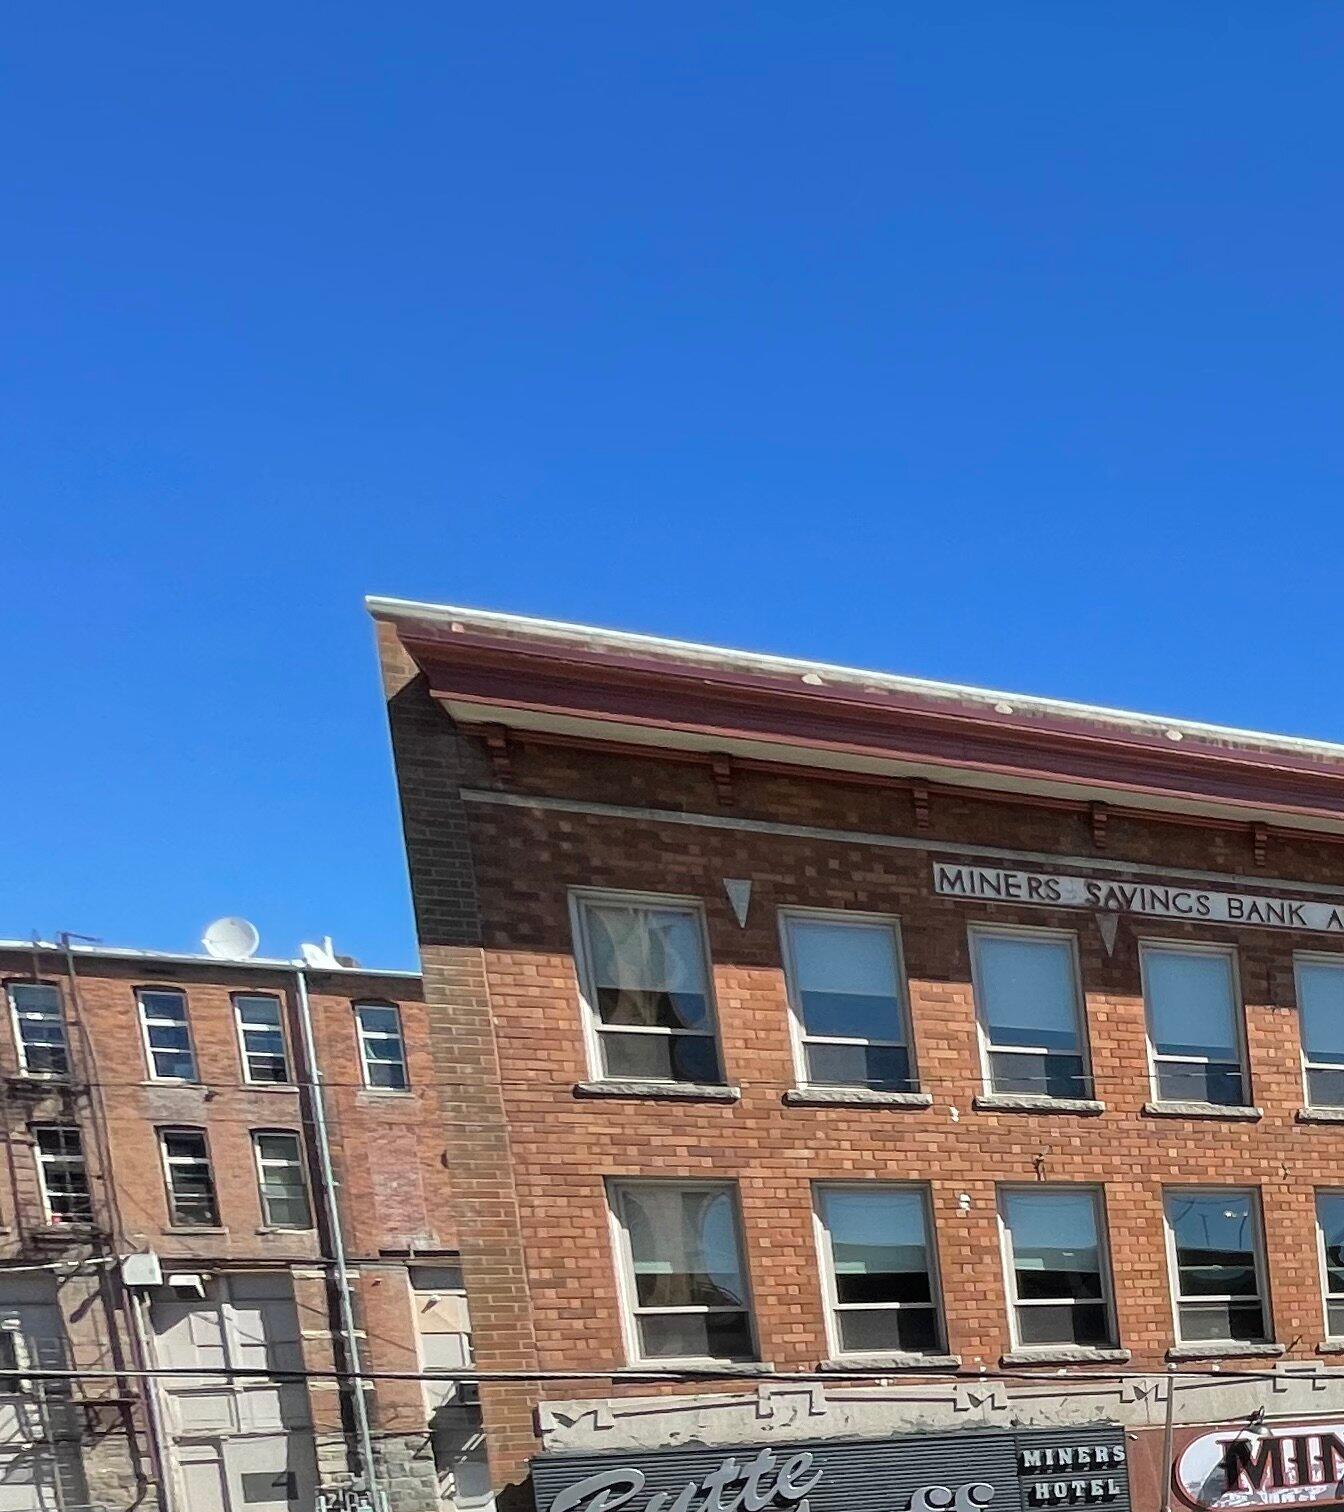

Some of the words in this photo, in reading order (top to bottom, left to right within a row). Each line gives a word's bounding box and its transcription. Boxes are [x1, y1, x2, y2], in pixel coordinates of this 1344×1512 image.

[939, 867, 1061, 901] MINERS
[1086, 880, 1211, 916] SAVINGS
[1227, 897, 1307, 926] BANK
[1022, 1445, 1126, 1467] MINERS
[1035, 1479, 1120, 1499] HOTEL
